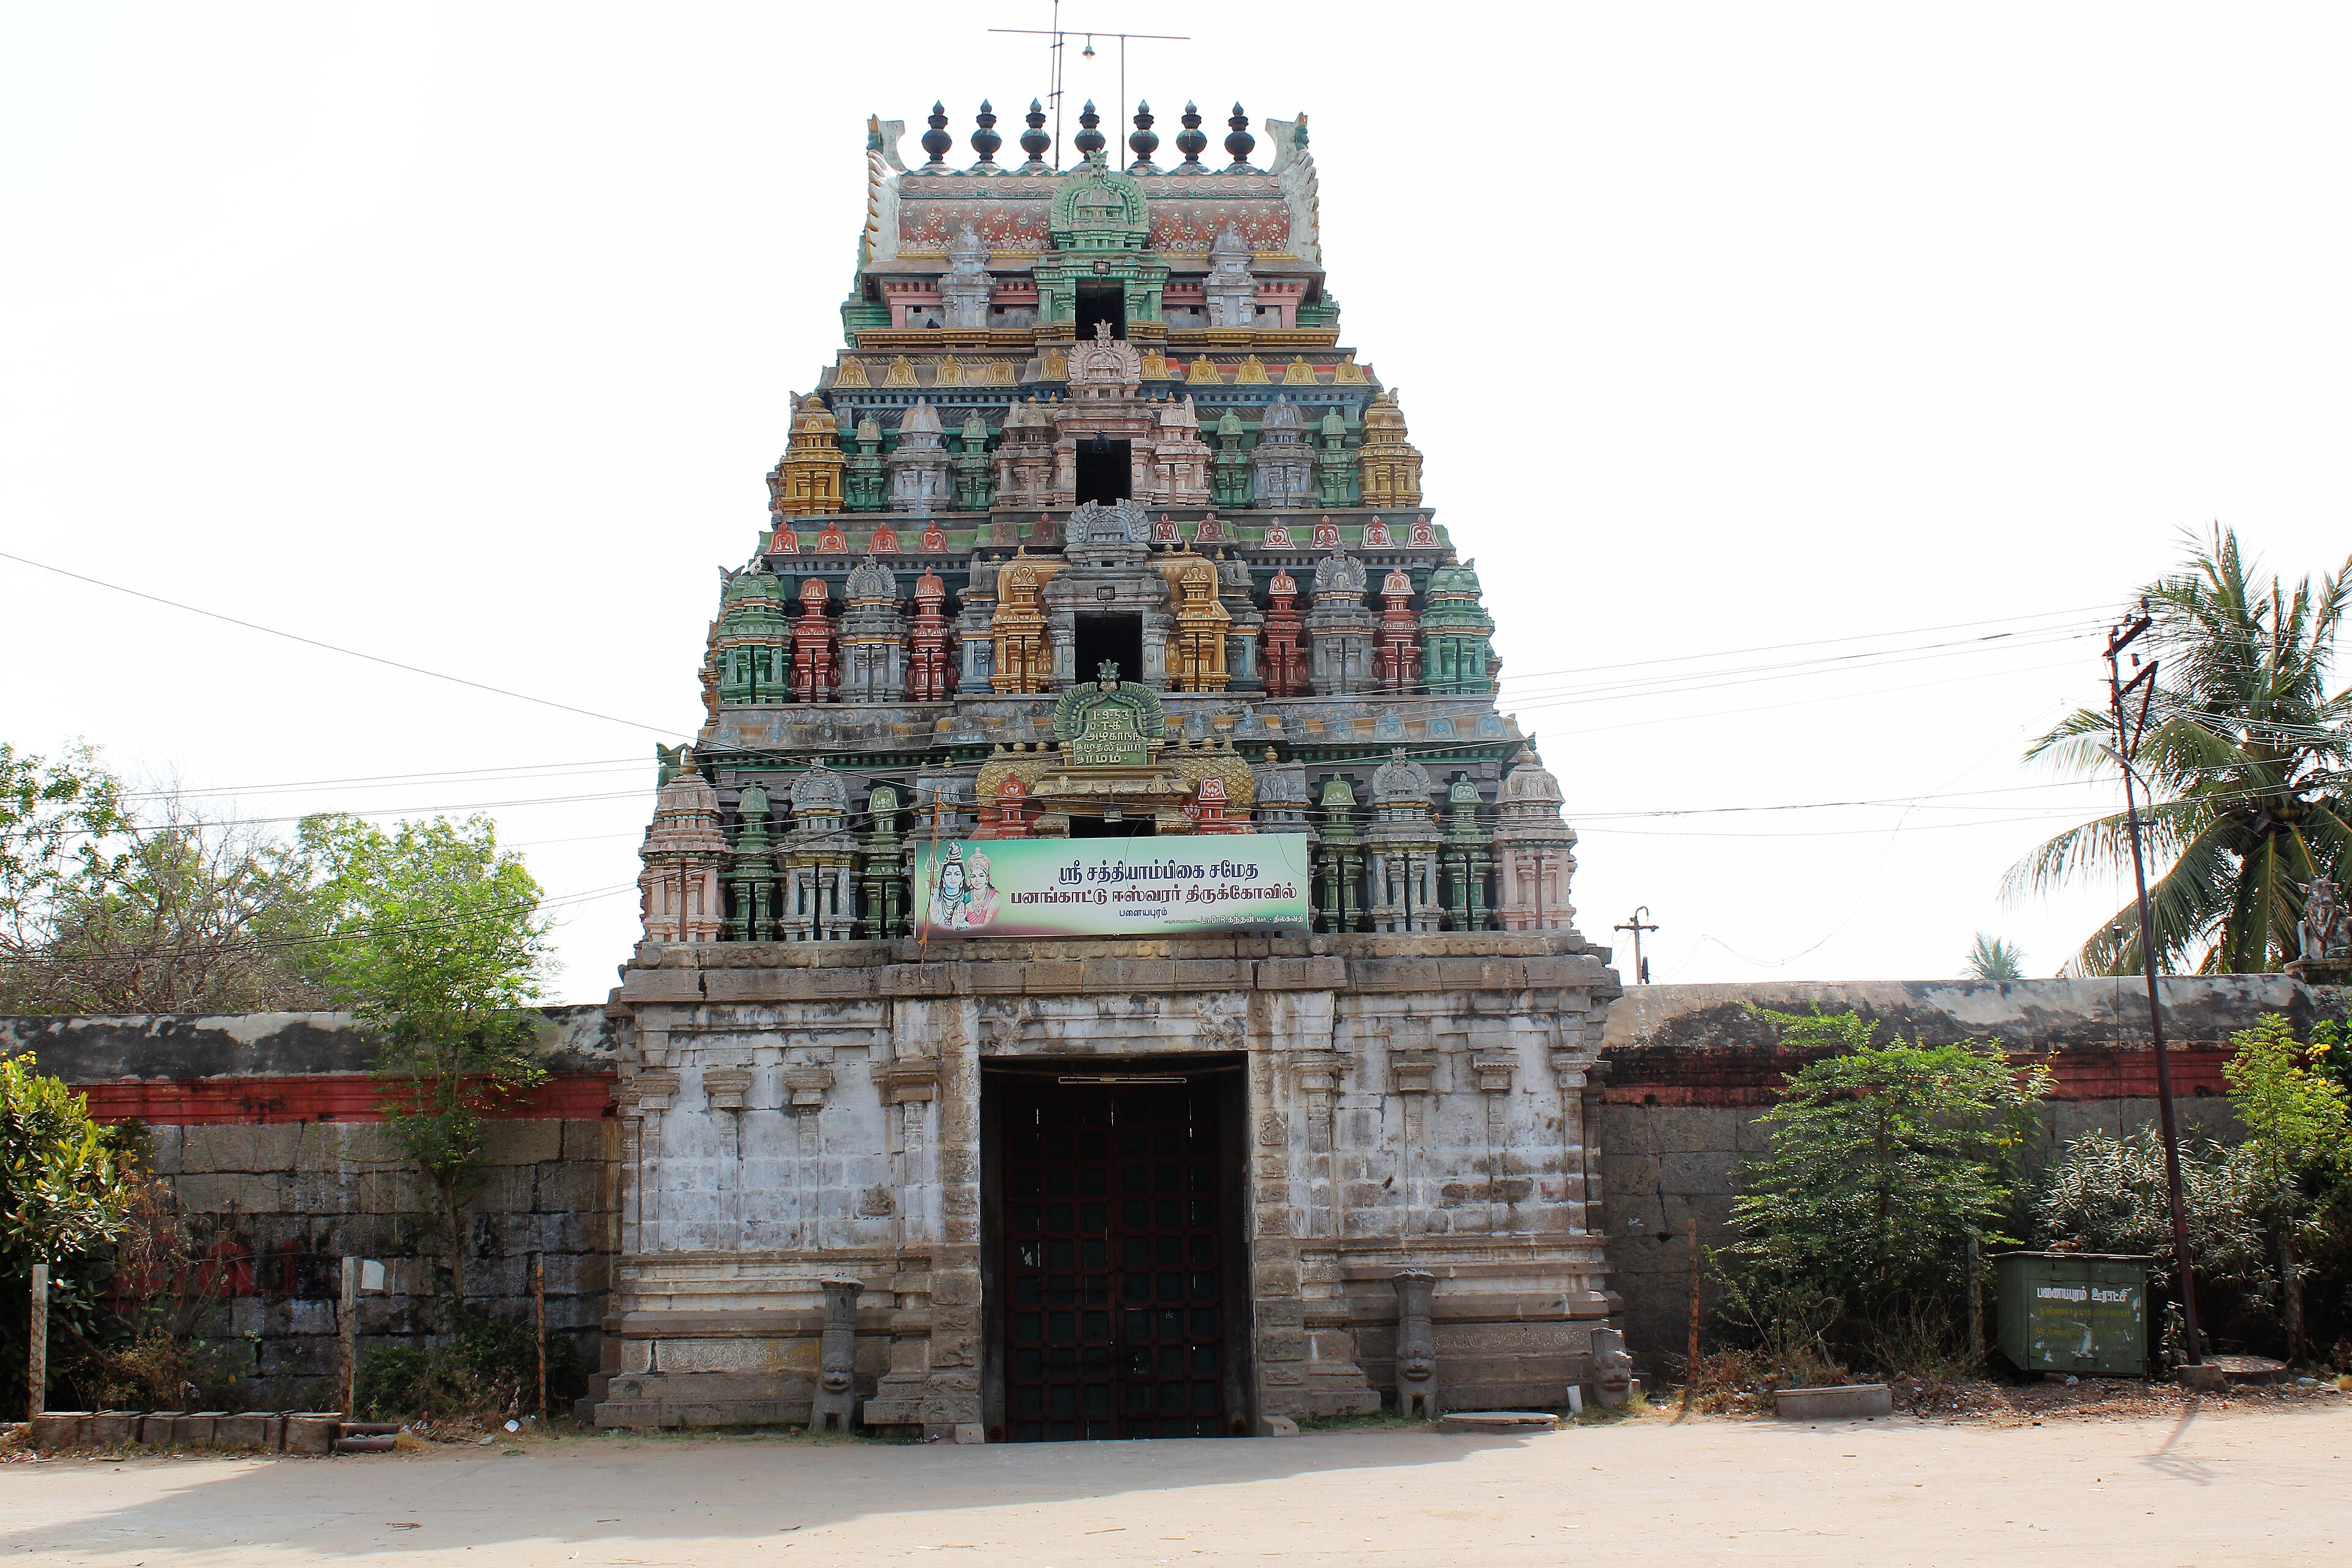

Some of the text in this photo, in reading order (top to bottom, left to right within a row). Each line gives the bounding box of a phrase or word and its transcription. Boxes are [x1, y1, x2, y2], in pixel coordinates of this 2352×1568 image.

[1093, 710, 1129, 720] 1-9-53
[1087, 858, 1205, 886] சத்தியாம்பிகை
[1209, 859, 1259, 882] சமேத
[1011, 881, 1297, 905] பனங்காட்டு ஈஸ்வரர் திருக்கோவில்
[1119, 907, 1167, 919] பனையபுரம்
[1273, 913, 1305, 924] திலகவதி
[2037, 1286, 2133, 1303] பனையபுரம் ஊராட்சி
